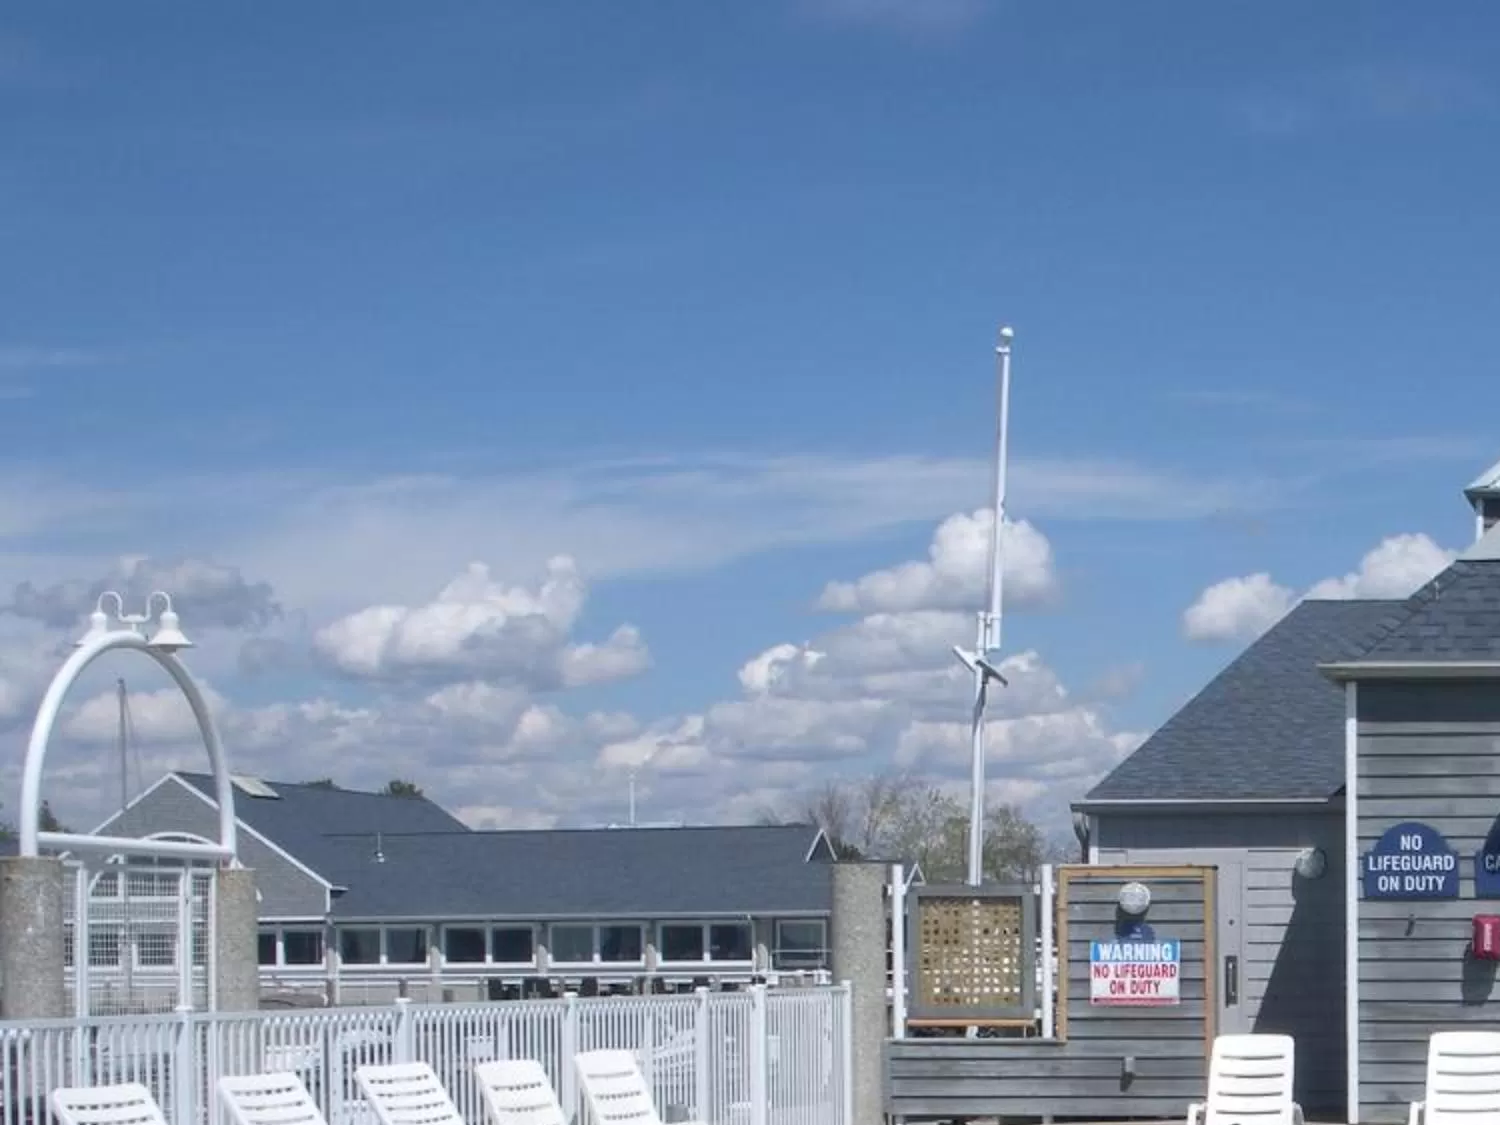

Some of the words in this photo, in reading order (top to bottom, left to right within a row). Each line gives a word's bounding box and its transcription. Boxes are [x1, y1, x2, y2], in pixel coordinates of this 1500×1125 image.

[1400, 834, 1423, 851] NO
[1368, 855, 1455, 871] LIFEGUARD
[1377, 875, 1400, 891] ON
[1404, 875, 1445, 891] DUTY
[1099, 943, 1173, 961] WARNING
[1093, 963, 1110, 979] NO
[1114, 963, 1177, 979] LIFEGUARD
[1109, 980, 1125, 995] ON
[1130, 980, 1161, 995] DUTY
